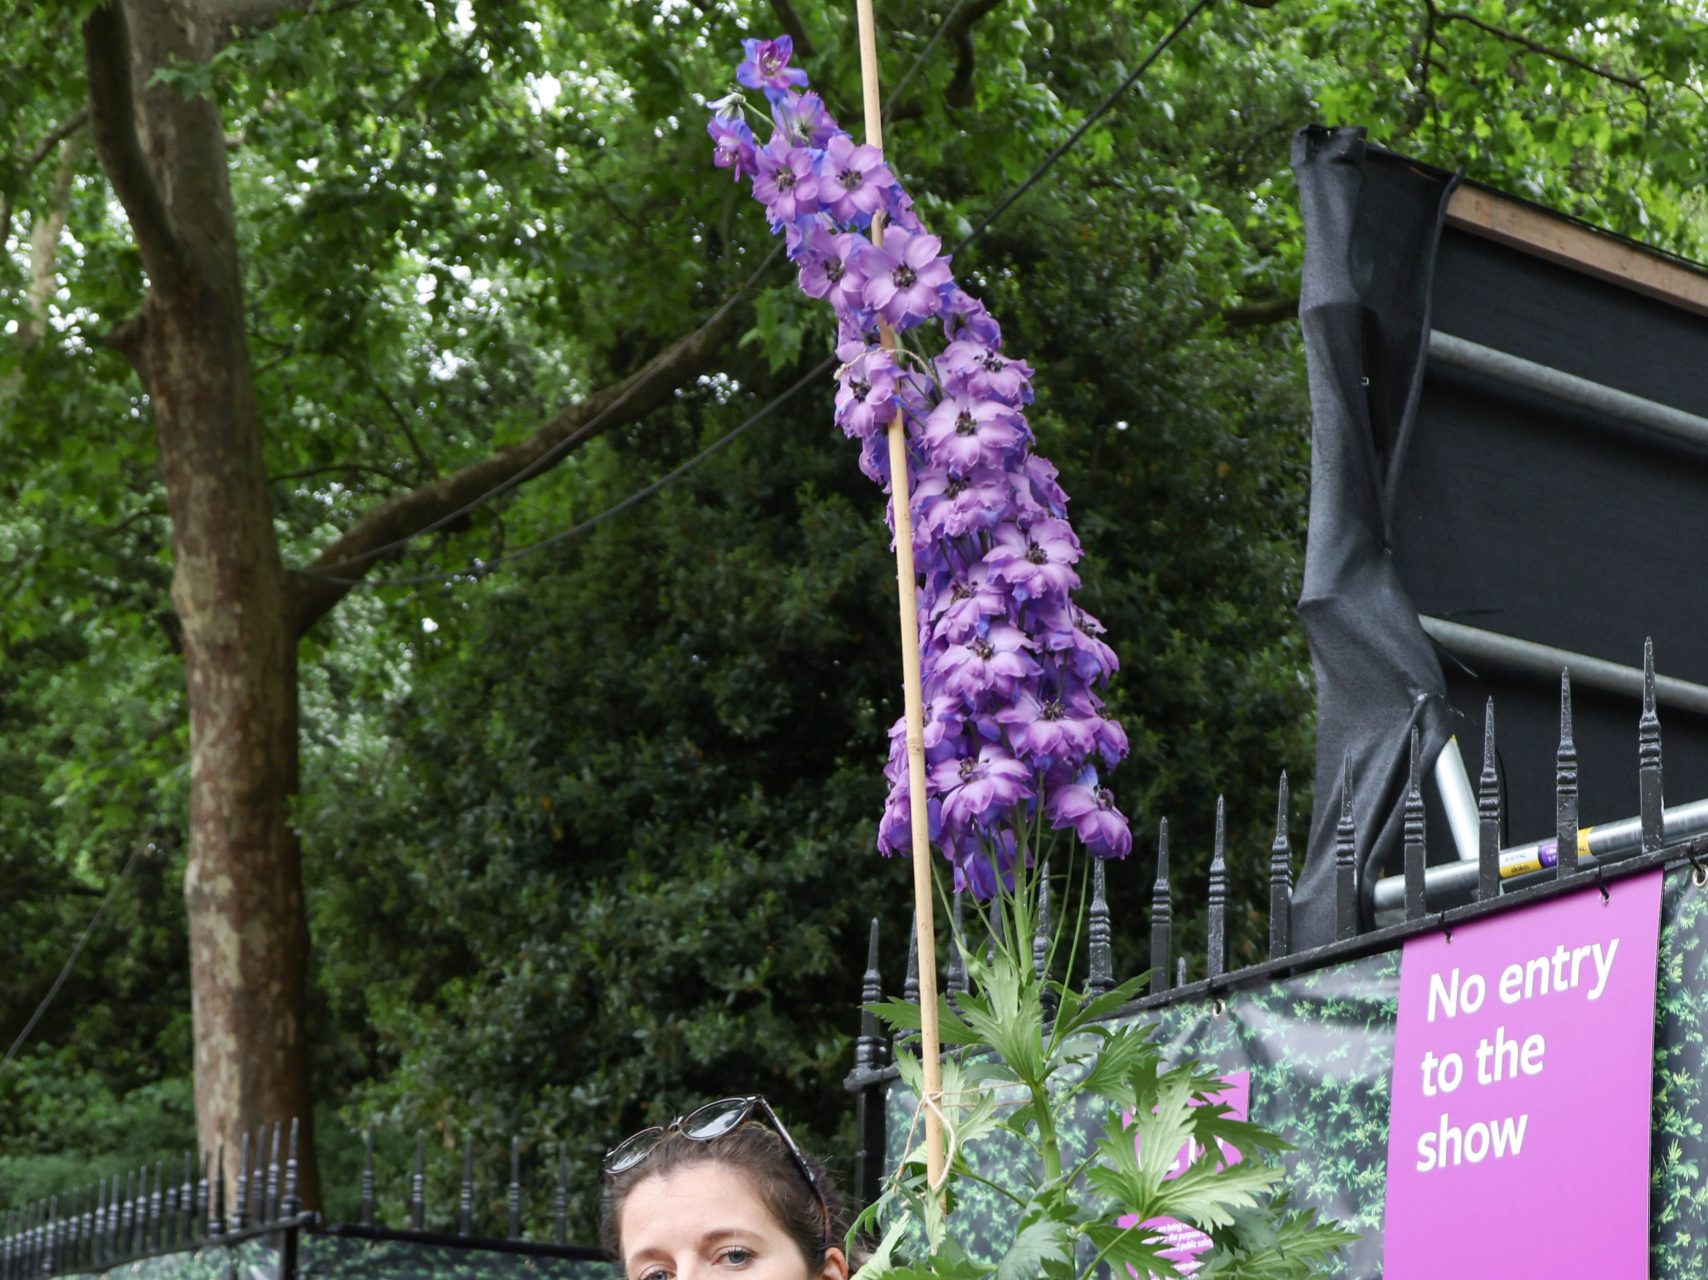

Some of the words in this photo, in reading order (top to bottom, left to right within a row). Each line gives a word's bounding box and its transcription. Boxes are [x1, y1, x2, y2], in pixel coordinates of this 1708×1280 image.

[1427, 968, 1486, 1023] No
[1499, 938, 1619, 1003] entry
[1421, 1051, 1463, 1097] to
[1475, 1026, 1545, 1085] the
[1416, 1113, 1528, 1172] show
